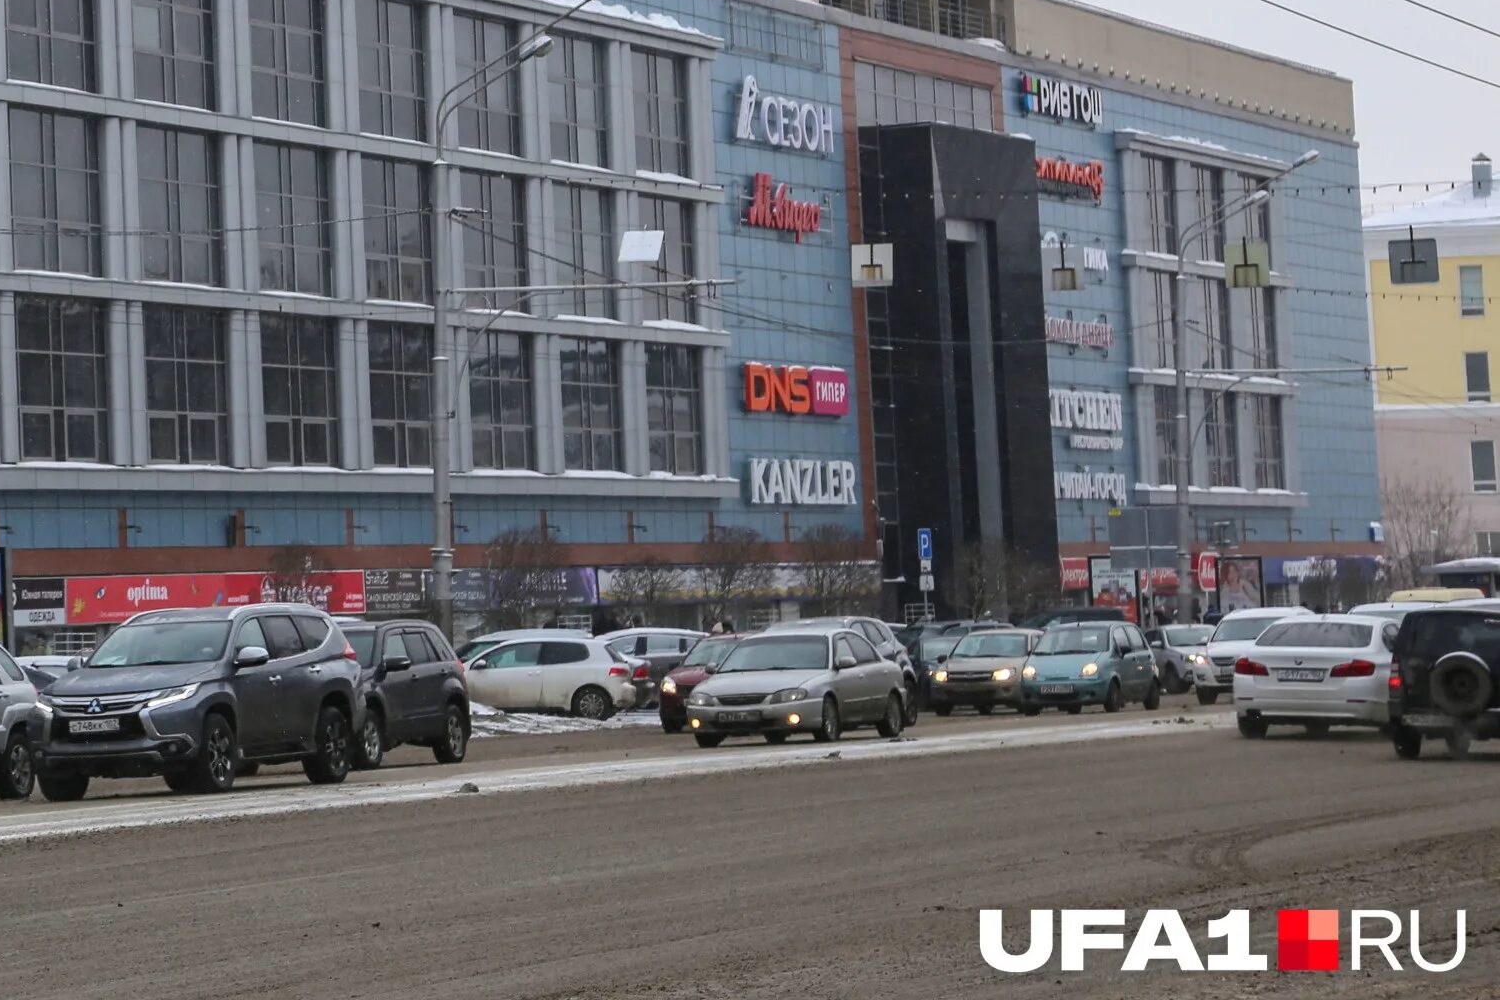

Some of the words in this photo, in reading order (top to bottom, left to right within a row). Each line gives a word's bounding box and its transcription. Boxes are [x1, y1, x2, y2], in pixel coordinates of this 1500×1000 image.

[761, 96, 834, 152] СЕЗОН
[744, 363, 810, 414] DNS
[815, 381, 846, 404] ГИПЕР
[750, 458, 857, 505] KANZLER
[127, 579, 168, 607] optima
